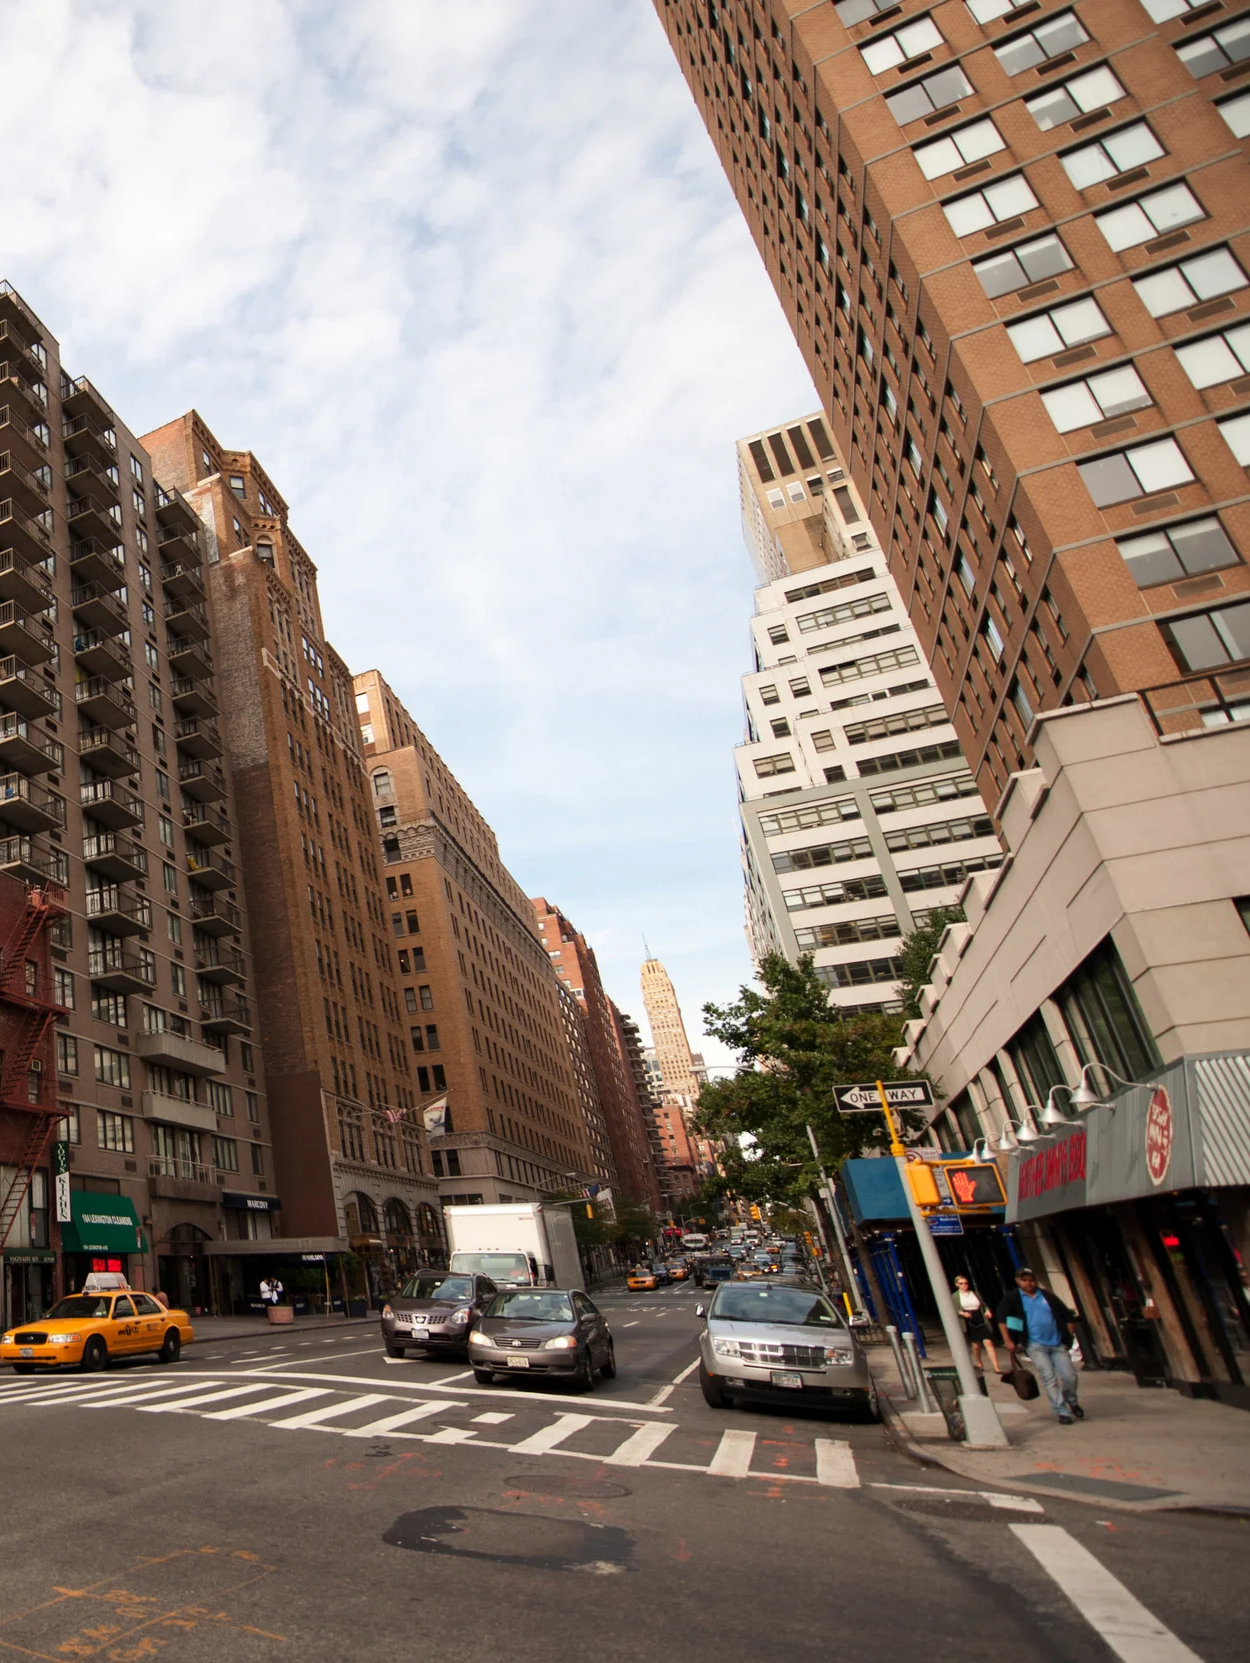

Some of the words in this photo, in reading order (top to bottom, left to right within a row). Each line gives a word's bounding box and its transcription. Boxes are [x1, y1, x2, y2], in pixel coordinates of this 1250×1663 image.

[850, 1092, 877, 1103] ONE
[888, 1089, 916, 1100] WAY
[58, 1143, 66, 1173] YOGI'S
